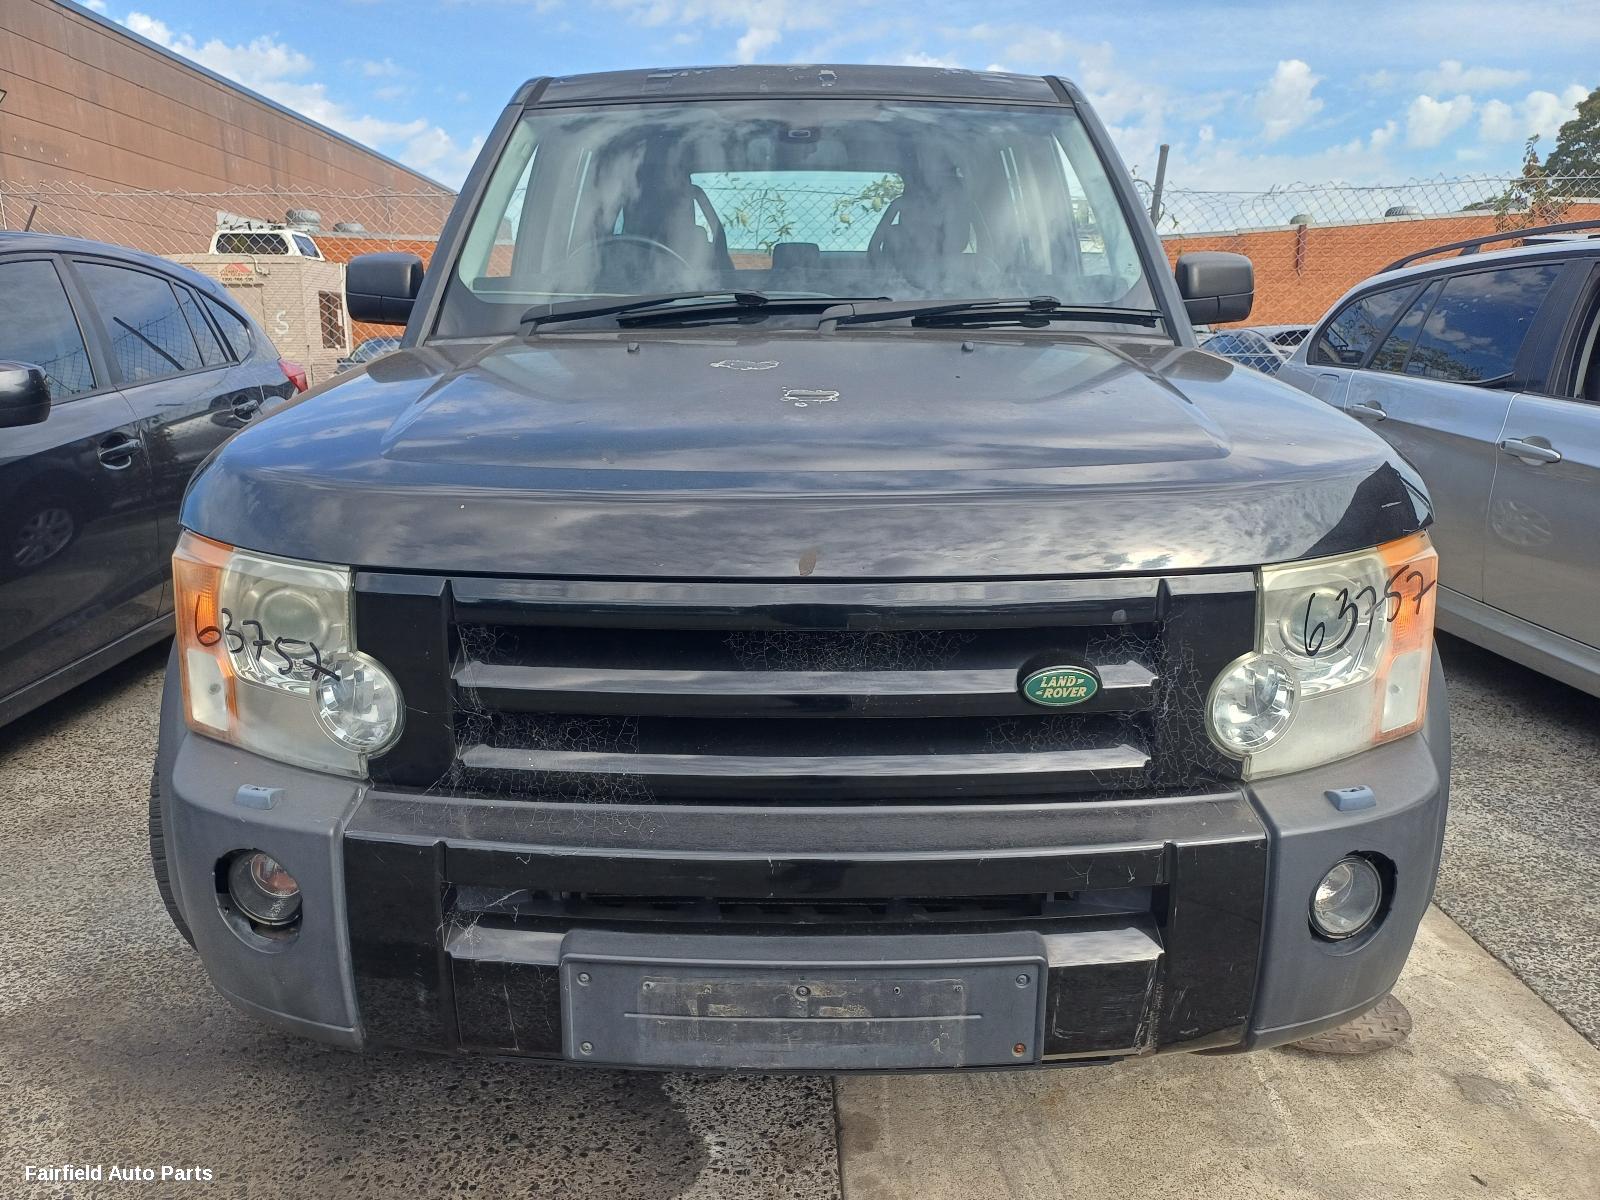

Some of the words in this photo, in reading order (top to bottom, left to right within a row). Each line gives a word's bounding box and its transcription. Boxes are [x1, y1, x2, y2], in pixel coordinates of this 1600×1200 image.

[1304, 565, 1436, 656] 63757
[195, 594, 341, 681] 63757
[1040, 675, 1076, 688] LAND
[1042, 686, 1088, 699] ROVER
